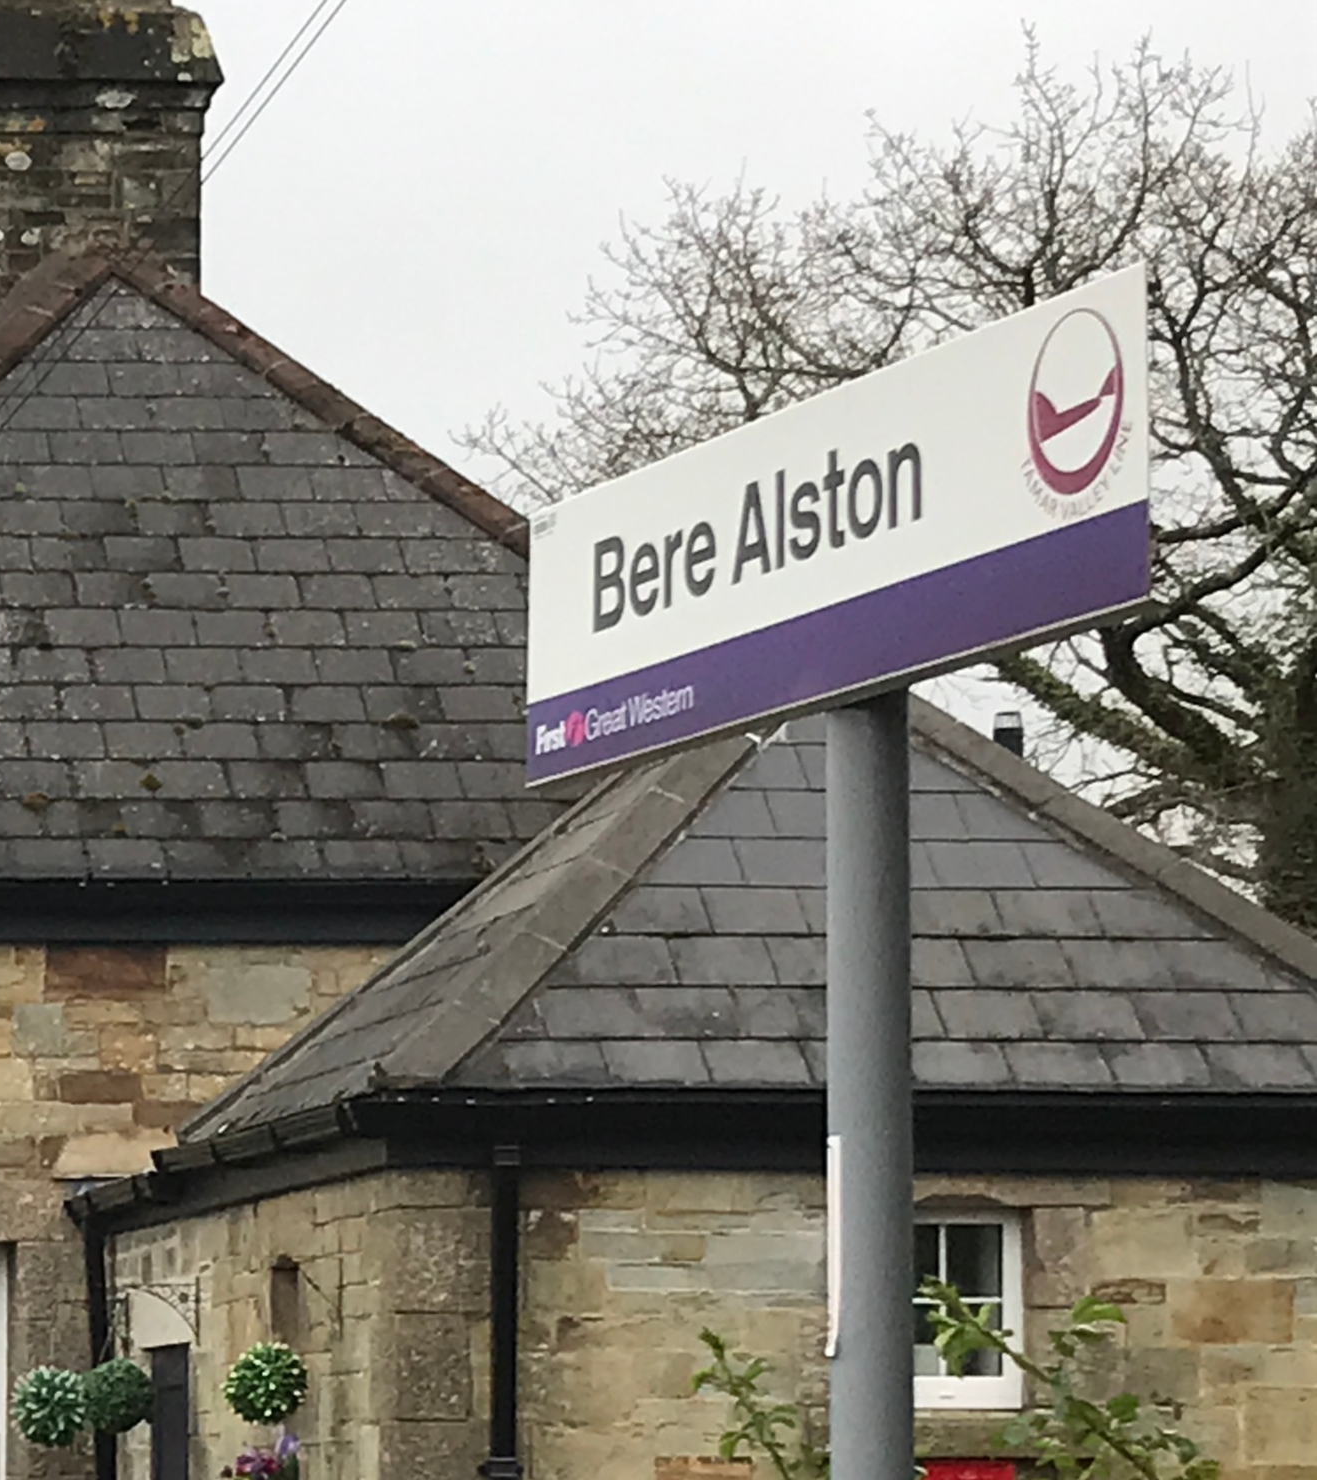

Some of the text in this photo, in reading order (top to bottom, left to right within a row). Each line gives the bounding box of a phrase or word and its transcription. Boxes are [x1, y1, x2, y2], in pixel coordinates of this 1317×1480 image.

[1020, 421, 1133, 521] TAMAR VALLEY LINE
[593, 442, 922, 633] Bere Alston
[535, 685, 695, 755] First Great Western
